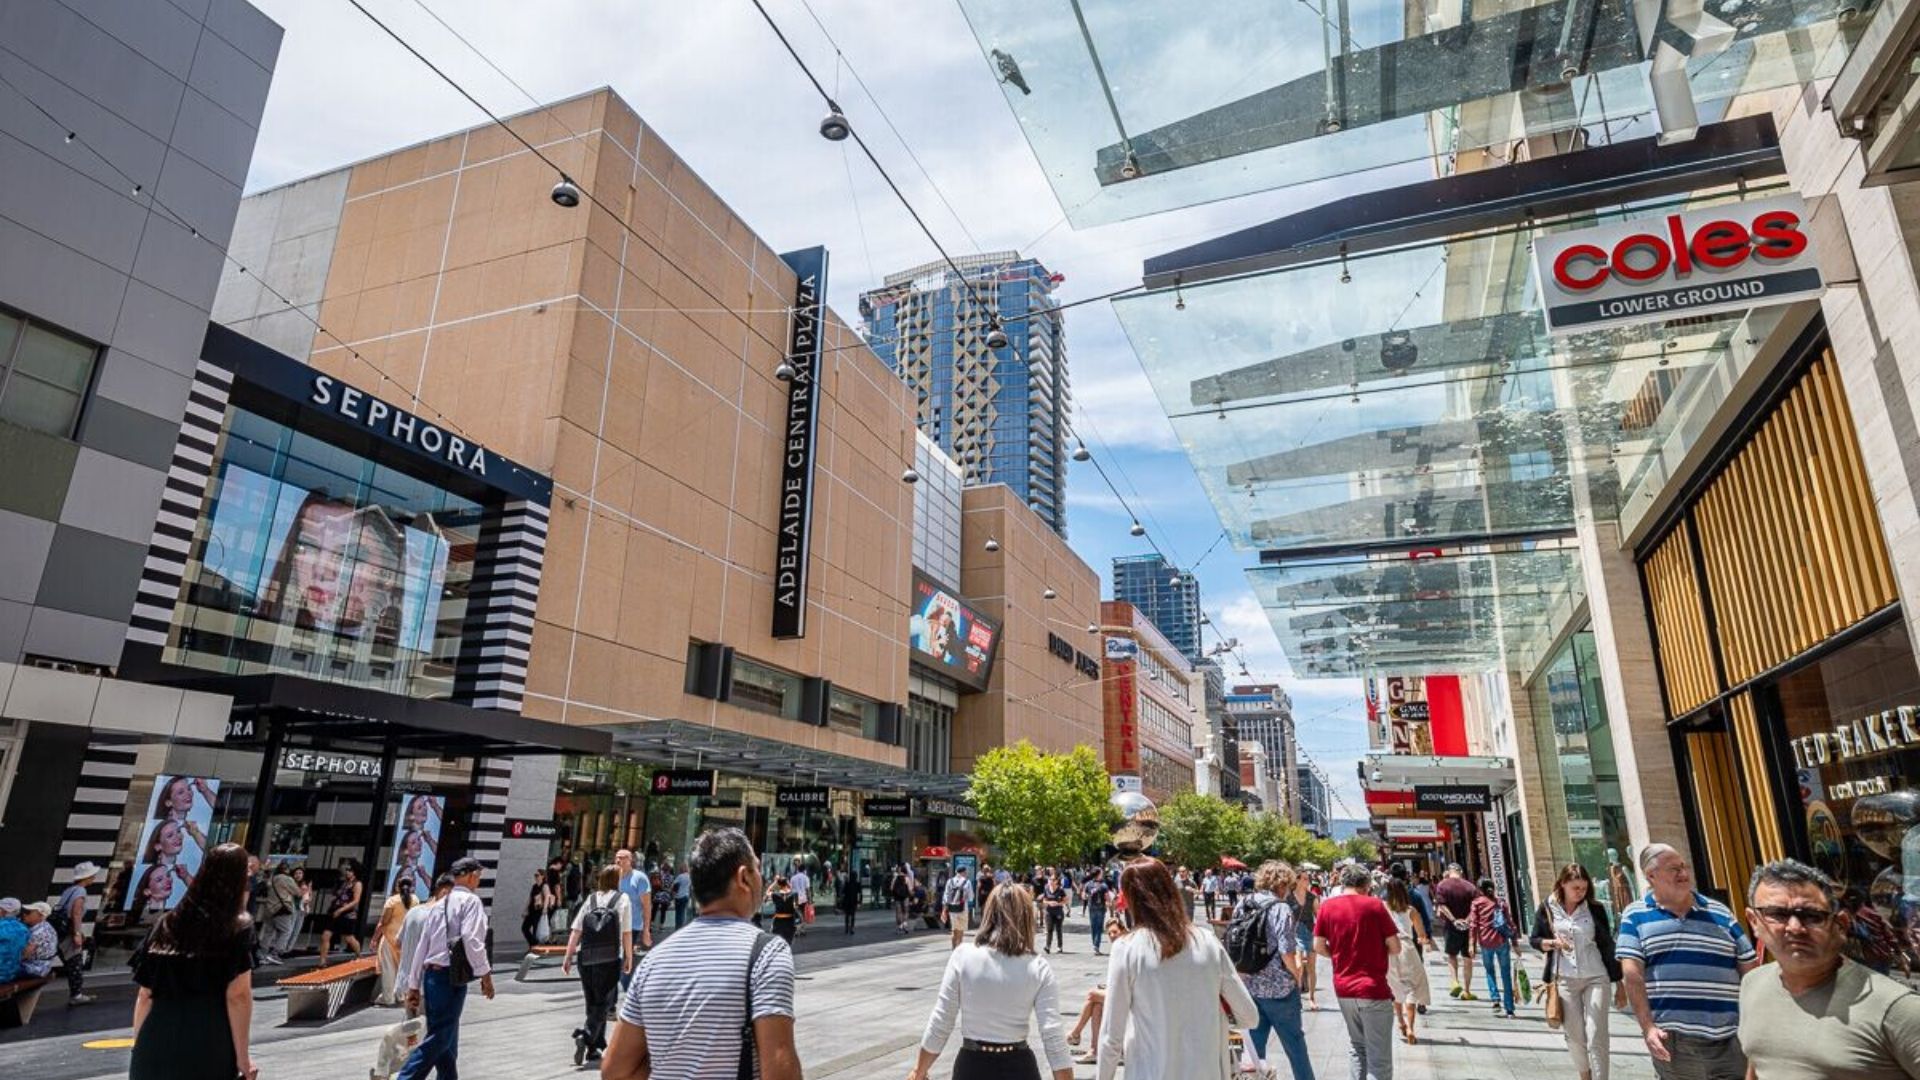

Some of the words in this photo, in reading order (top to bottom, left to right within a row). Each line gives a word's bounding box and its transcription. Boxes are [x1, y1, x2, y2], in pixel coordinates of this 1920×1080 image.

[1553, 210, 1808, 291] coles
[797, 274, 815, 348] PLAZA
[1599, 296, 1669, 318] LOWER
[1673, 281, 1765, 306] GROUND
[312, 375, 486, 475] SEPHORA
[788, 354, 810, 468] CENTRAL
[779, 478, 802, 607] ADELAIDE
[286, 753, 382, 777] SEPHORA
[1790, 732, 1830, 768] TED
[1837, 705, 1919, 758] BAKER
[671, 778, 709, 788] lululemon
[779, 791, 826, 802] CALIBRE
[1488, 820, 1498, 842] HAIR
